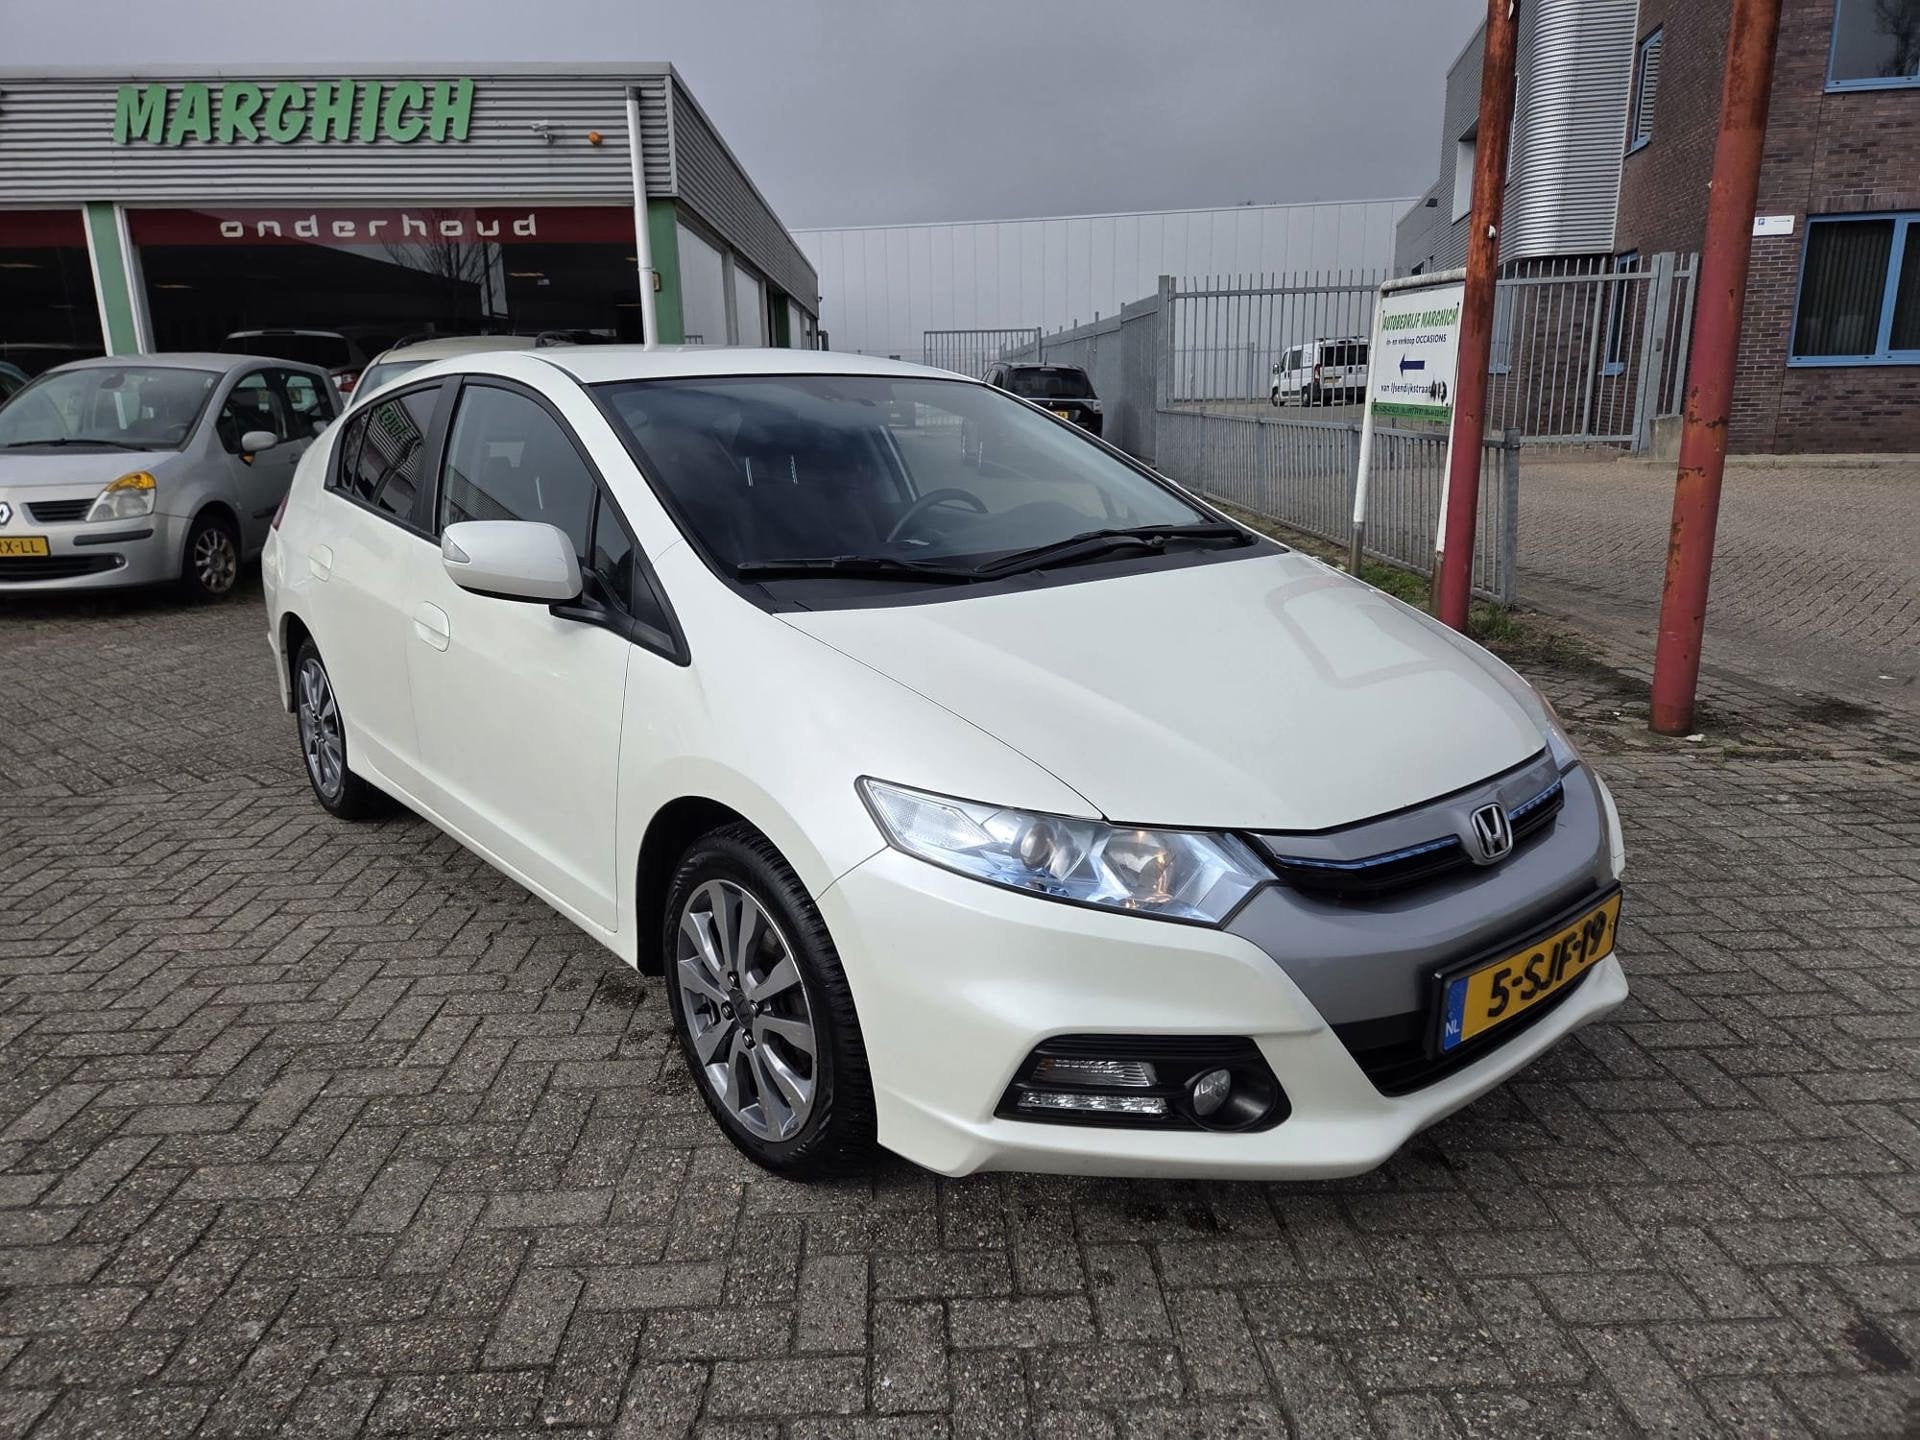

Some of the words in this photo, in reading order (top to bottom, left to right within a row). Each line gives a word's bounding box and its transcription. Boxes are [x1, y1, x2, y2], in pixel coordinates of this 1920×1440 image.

[112, 78, 475, 145] MARGHICH
[220, 213, 538, 238] onderhoud
[1382, 312, 1420, 331] AUTOBEDRIJF
[1421, 307, 1458, 328] MARGHICH
[1415, 334, 1447, 344] OCCASIONS
[1487, 910, 1607, 1018] 5-SJF-19
[1445, 1020, 1461, 1038] NL
